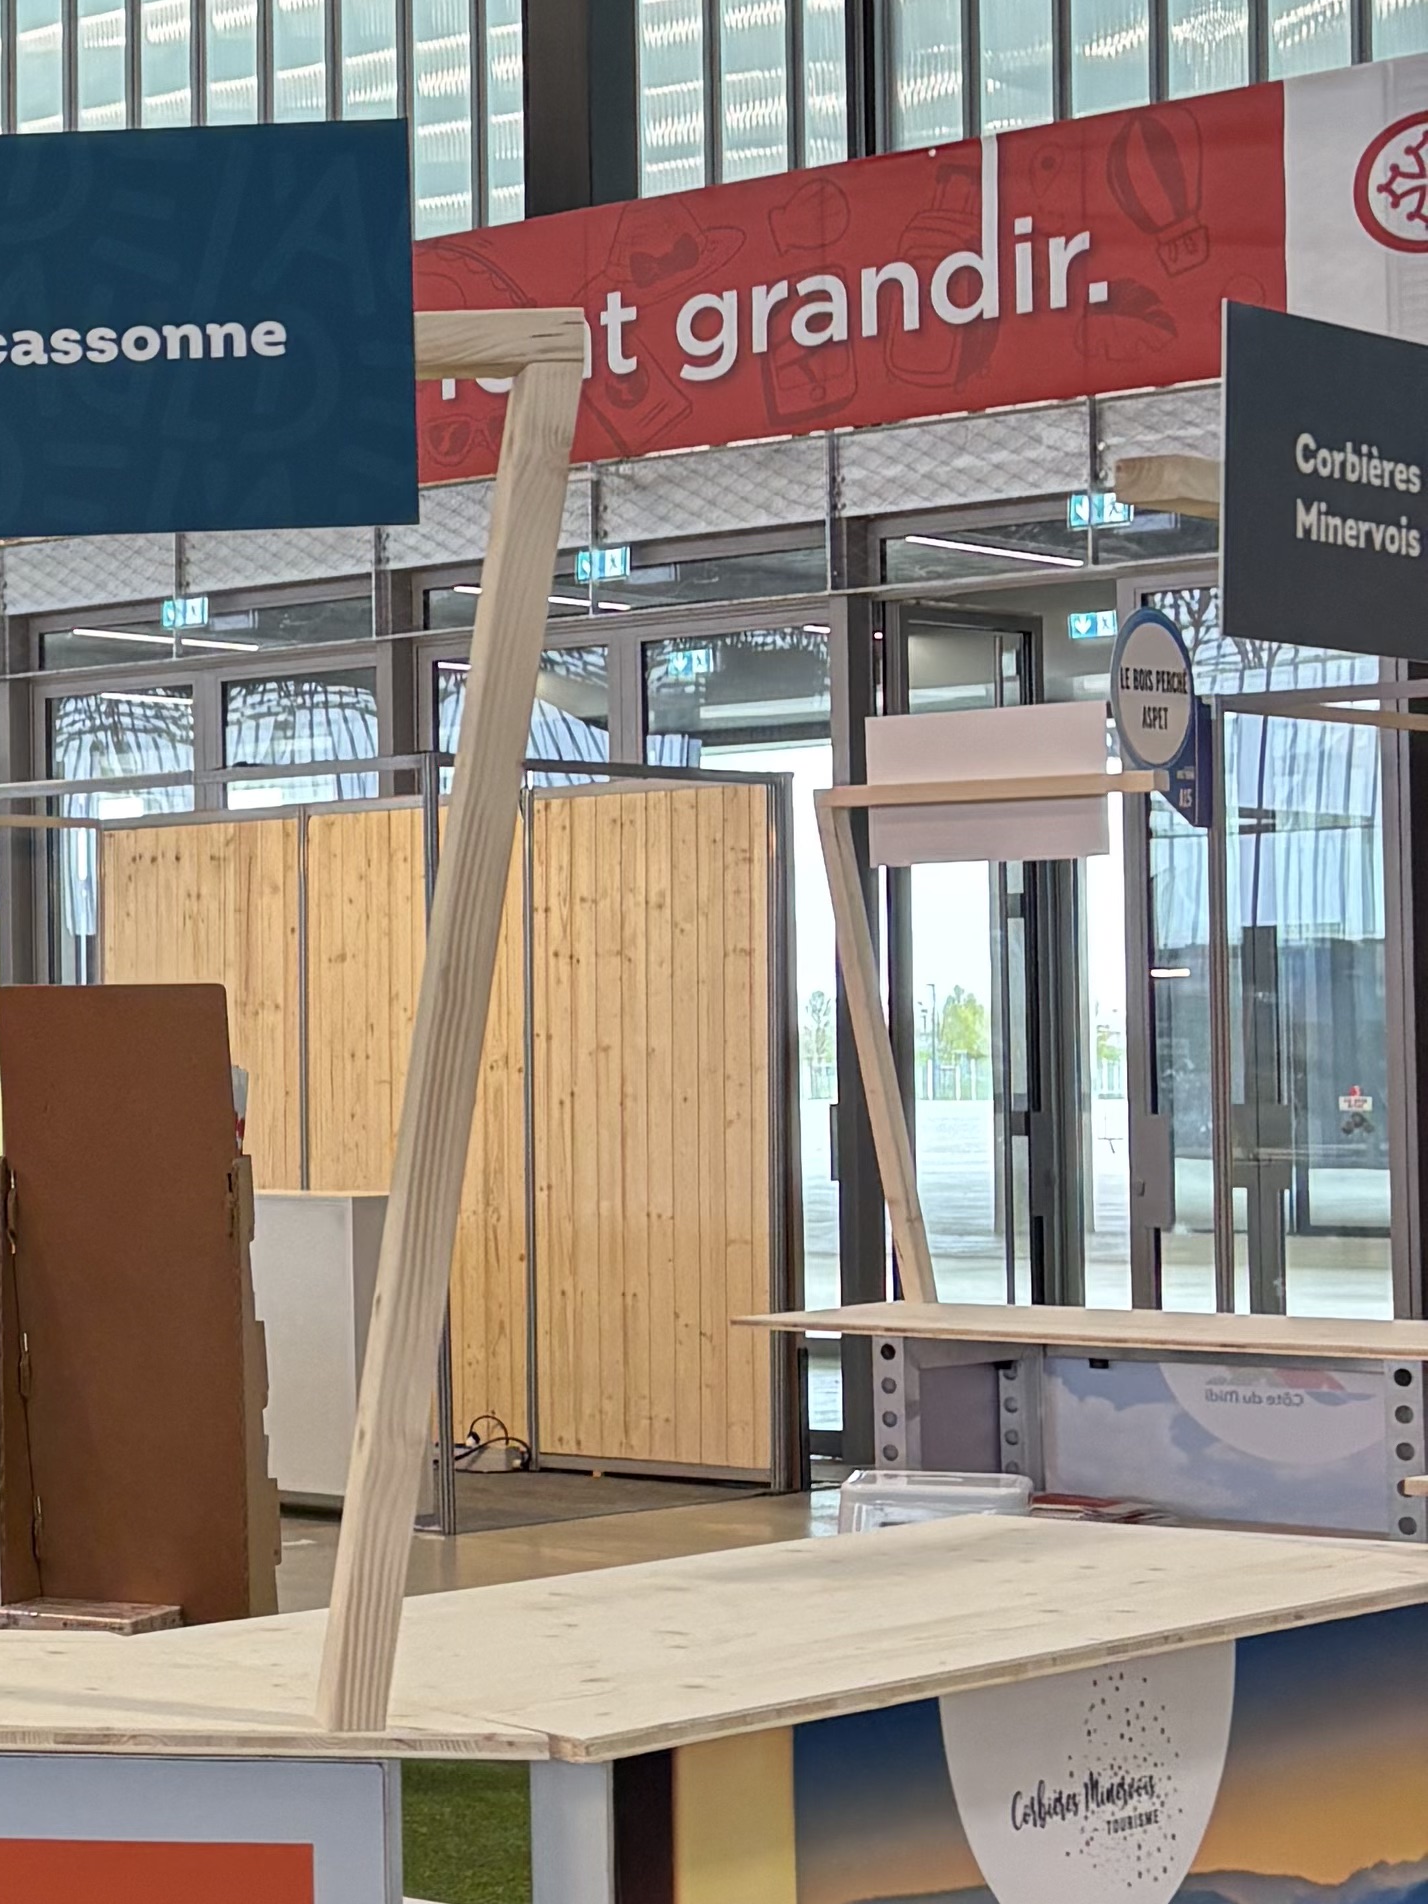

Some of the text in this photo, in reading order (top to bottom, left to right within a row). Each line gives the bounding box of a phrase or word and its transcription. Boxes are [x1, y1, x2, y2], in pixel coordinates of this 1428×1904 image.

[675, 135, 1110, 381] grandir.
[1295, 432, 1423, 494] Corbières
[1295, 497, 1422, 558] Minervois
[1120, 667, 1131, 691] LE
[1133, 670, 1153, 693] BOIS
[1142, 705, 1169, 731] ASPET
[1106, 1809, 1159, 1835] TOURISME
